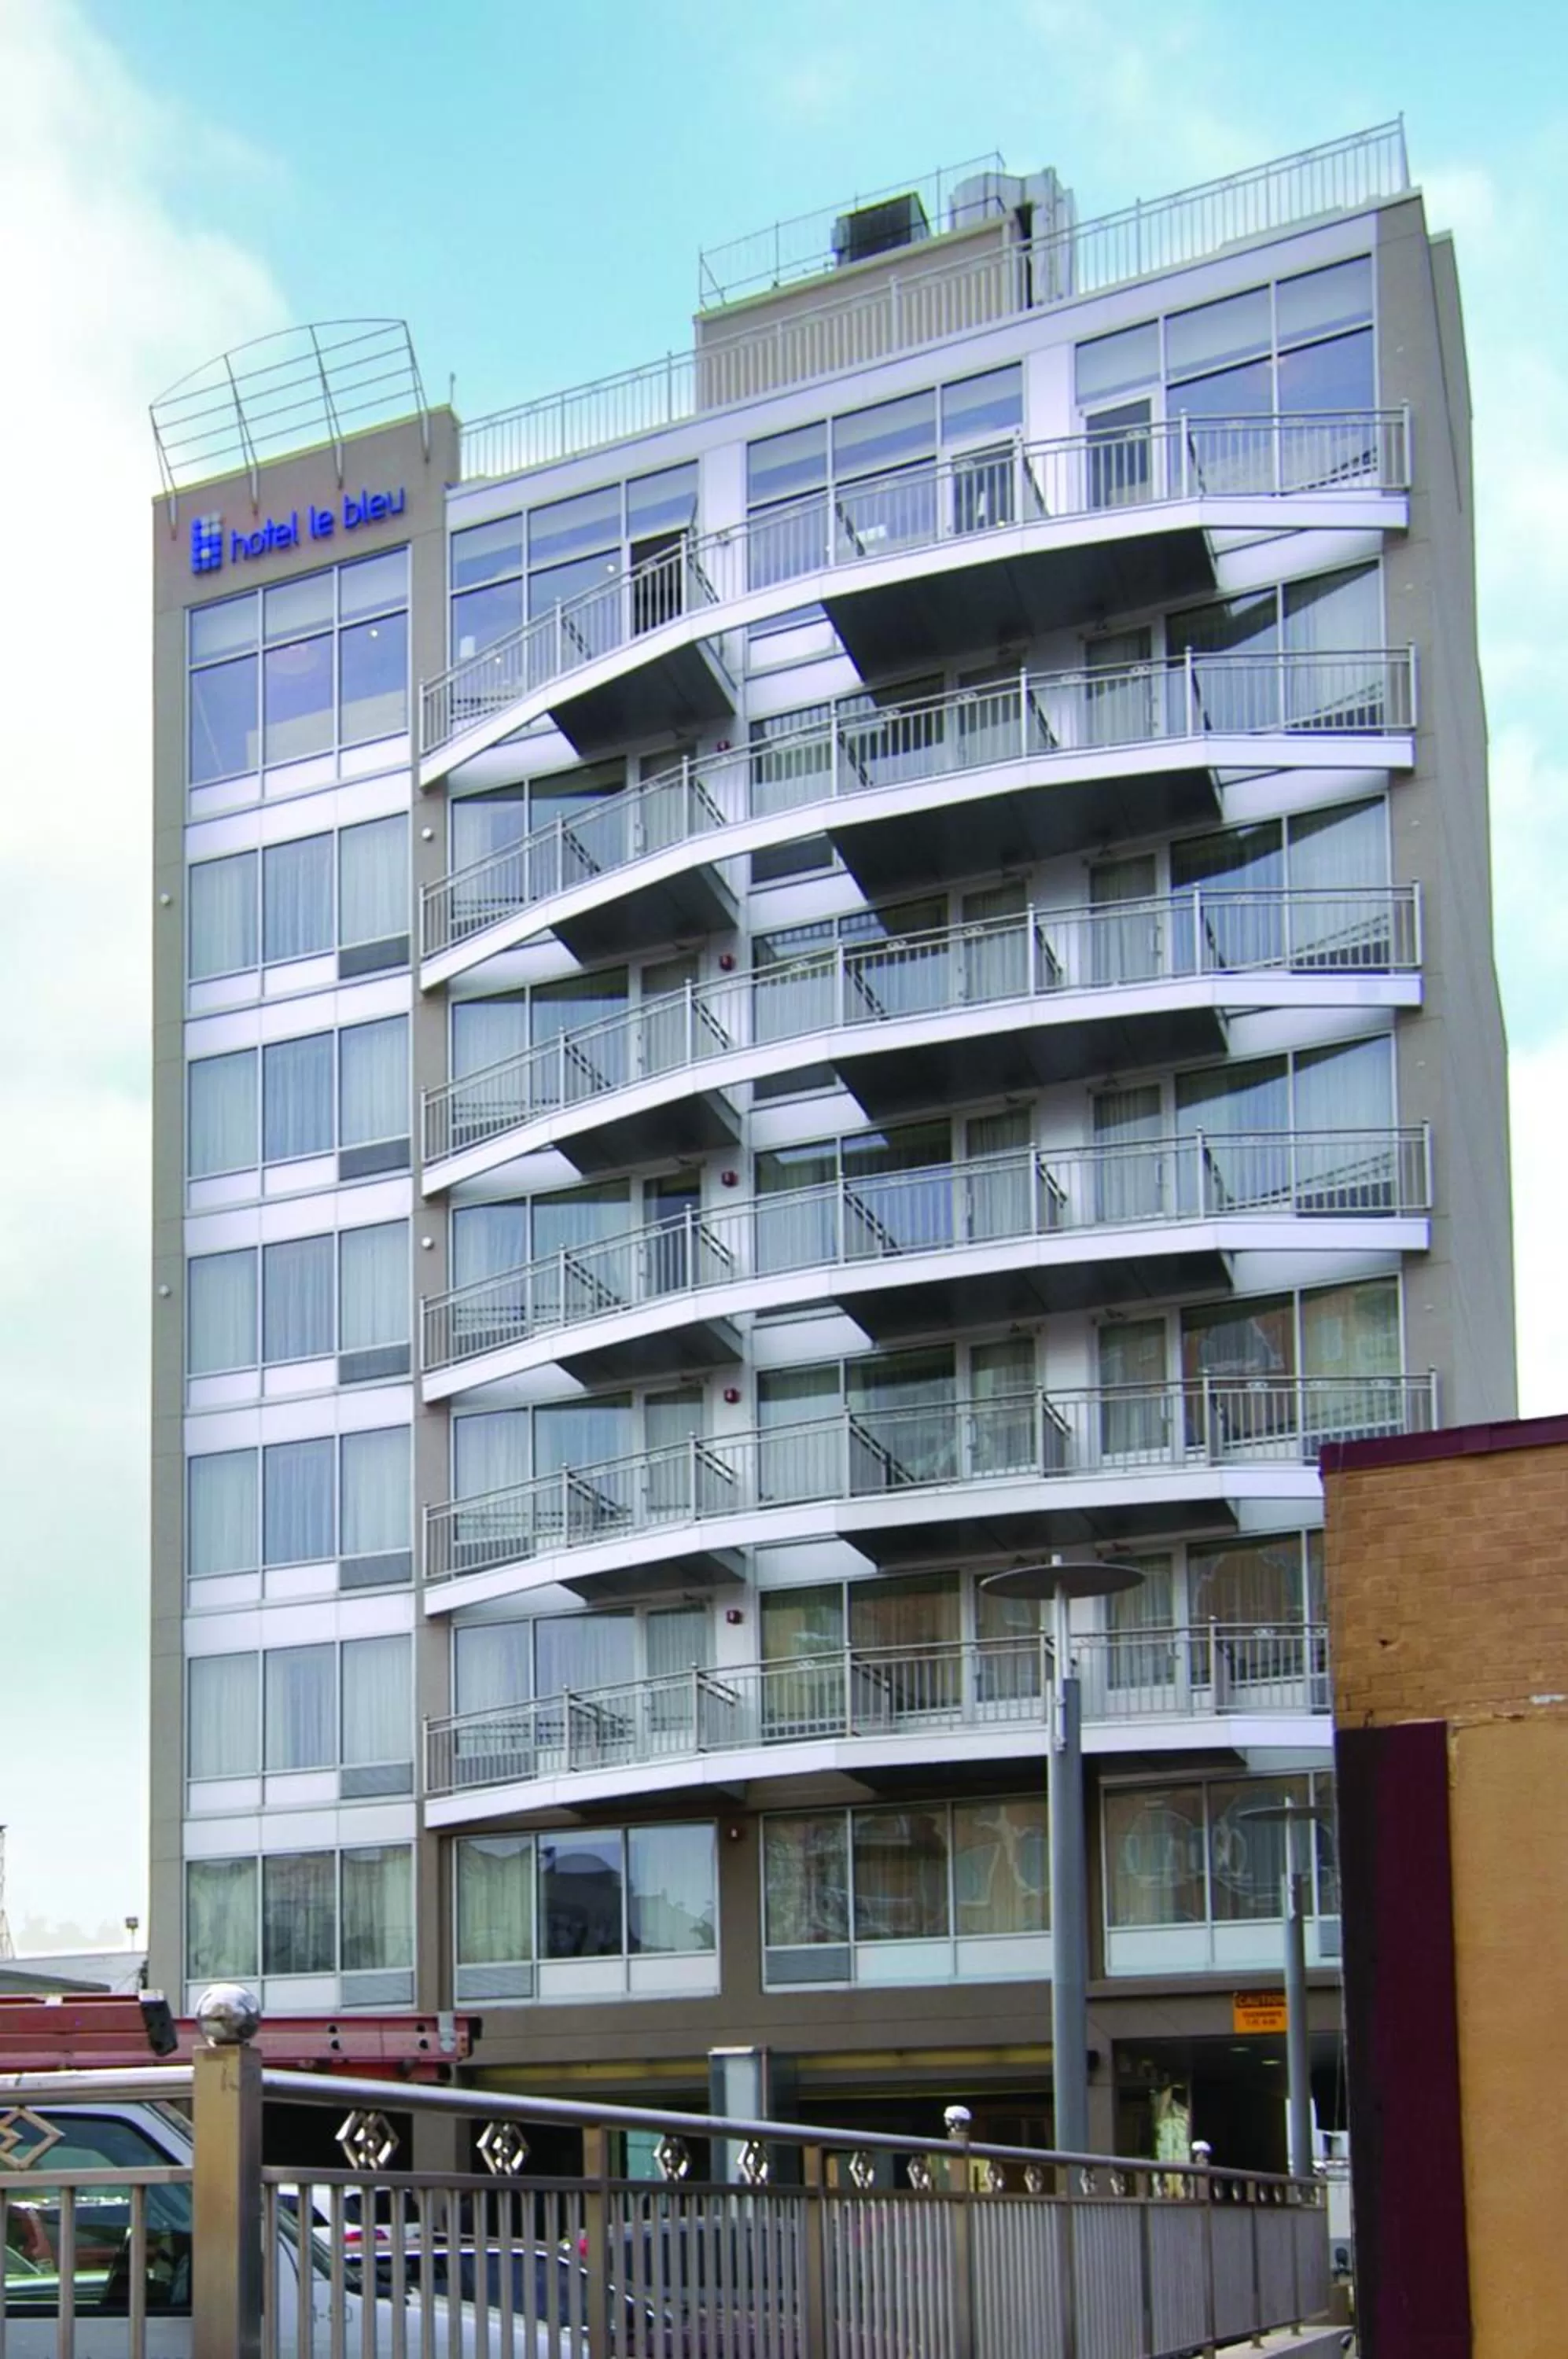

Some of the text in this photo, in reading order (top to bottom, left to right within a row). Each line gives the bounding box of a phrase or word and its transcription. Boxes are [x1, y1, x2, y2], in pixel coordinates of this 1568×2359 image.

[230, 487, 406, 563] hotel le bleu
